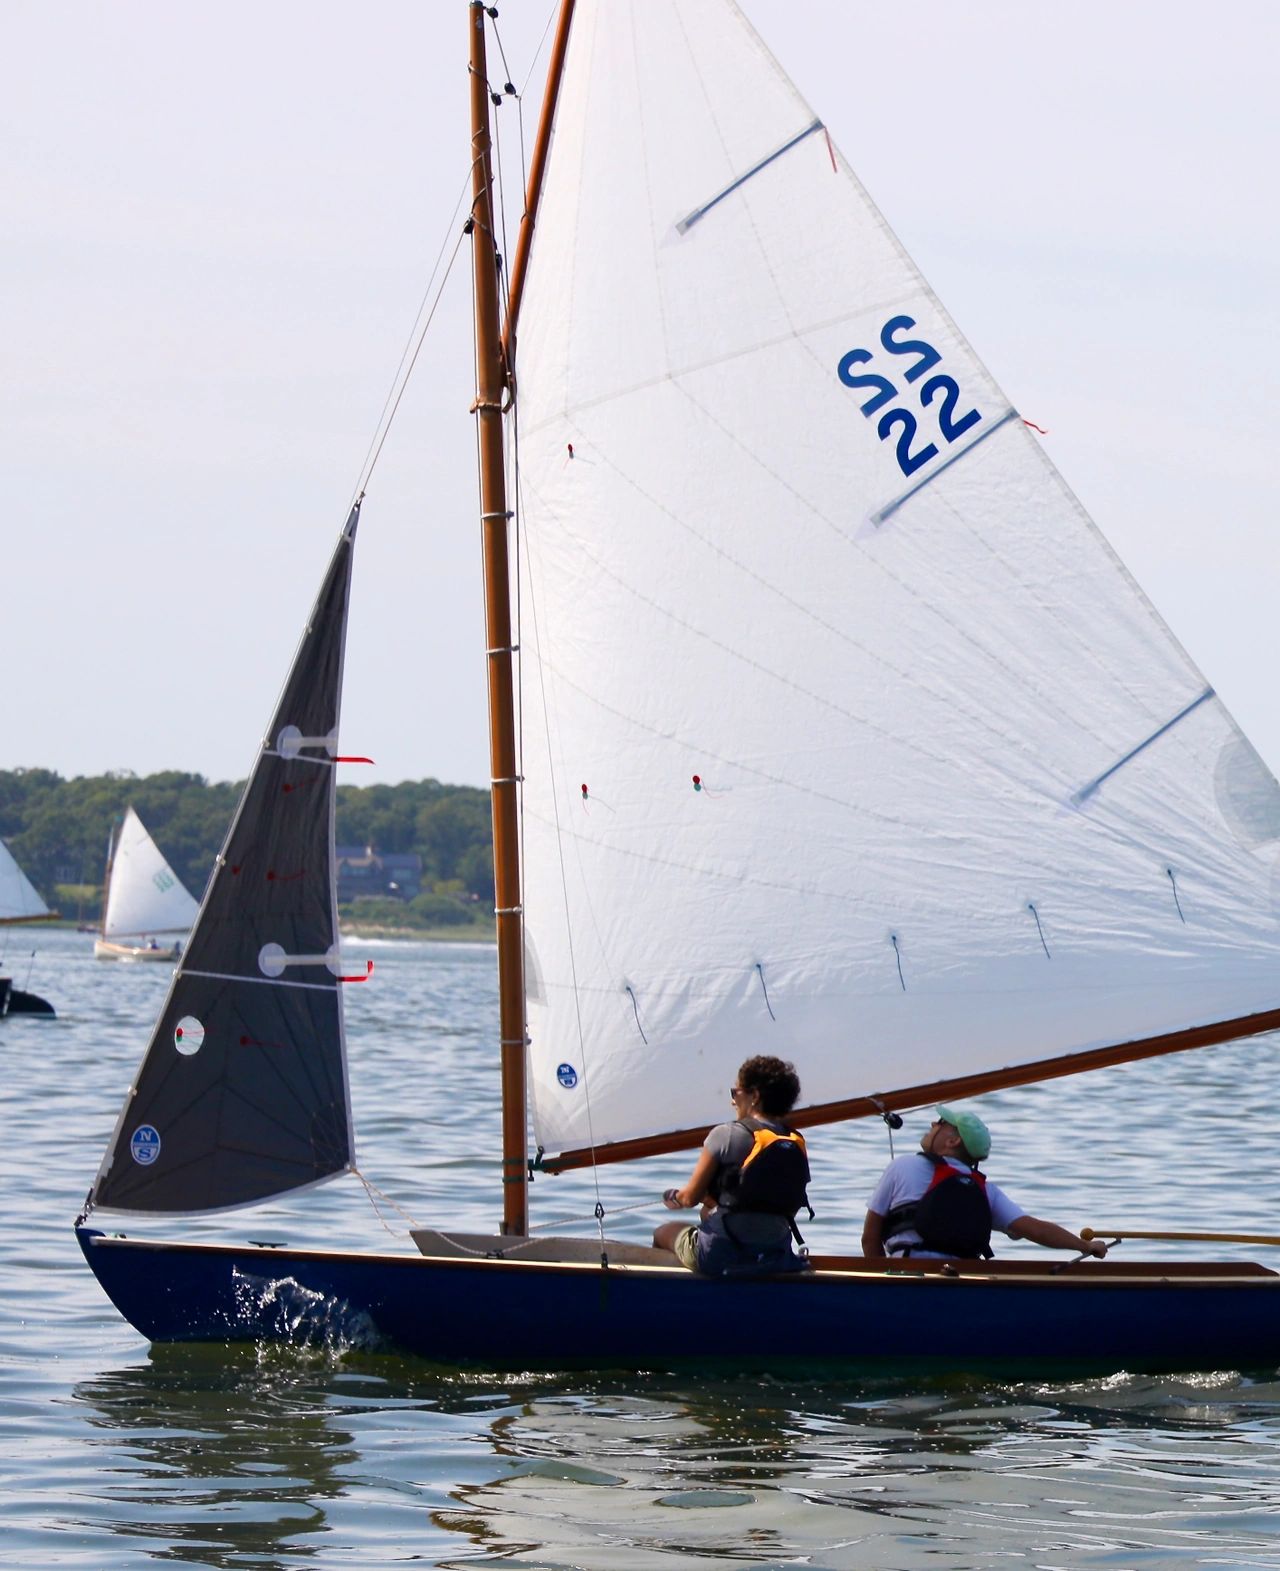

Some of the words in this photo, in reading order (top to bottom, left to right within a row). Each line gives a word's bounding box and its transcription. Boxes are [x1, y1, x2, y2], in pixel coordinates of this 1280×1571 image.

[878, 373, 983, 477] 22
[139, 1130, 152, 1141] N
[138, 1148, 151, 1158] S
